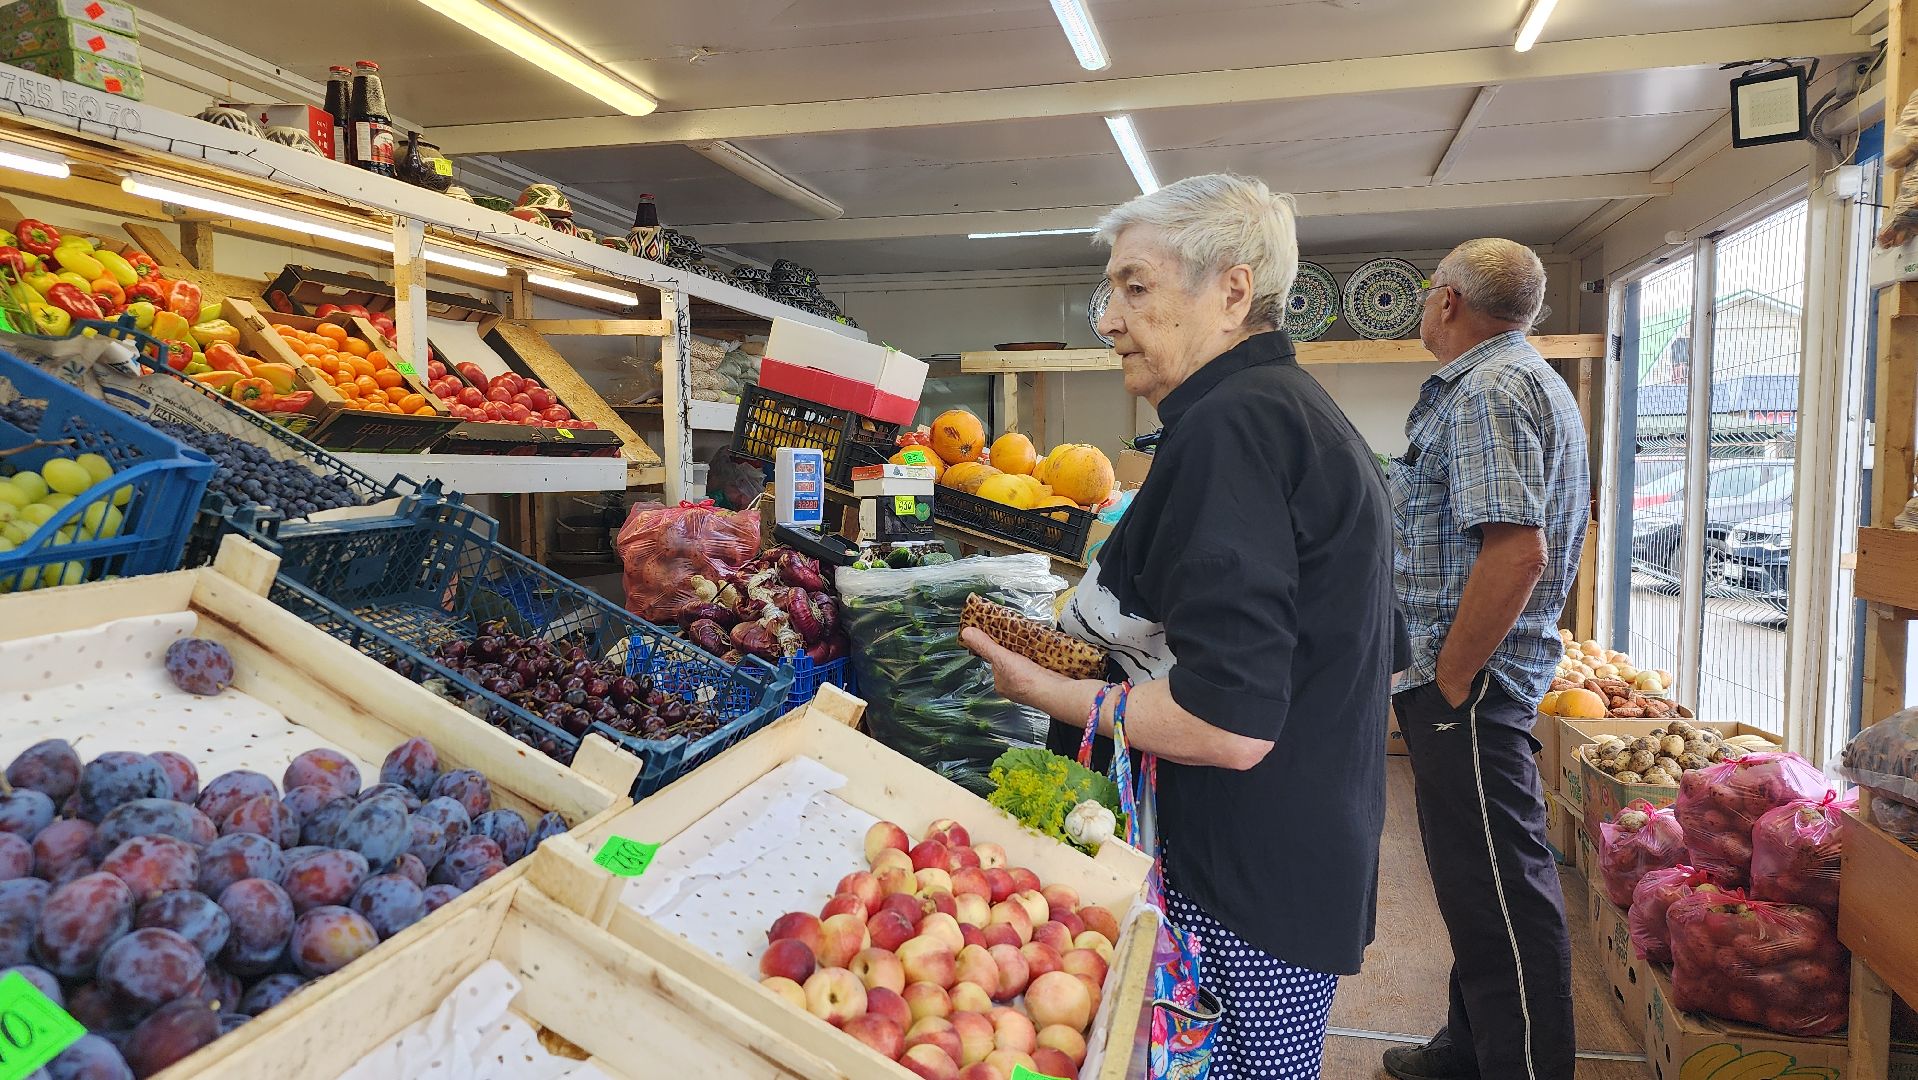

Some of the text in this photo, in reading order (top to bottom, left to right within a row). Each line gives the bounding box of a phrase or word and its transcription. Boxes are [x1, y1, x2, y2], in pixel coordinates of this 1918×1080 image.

[0, 71, 142, 134] 755 50 70
